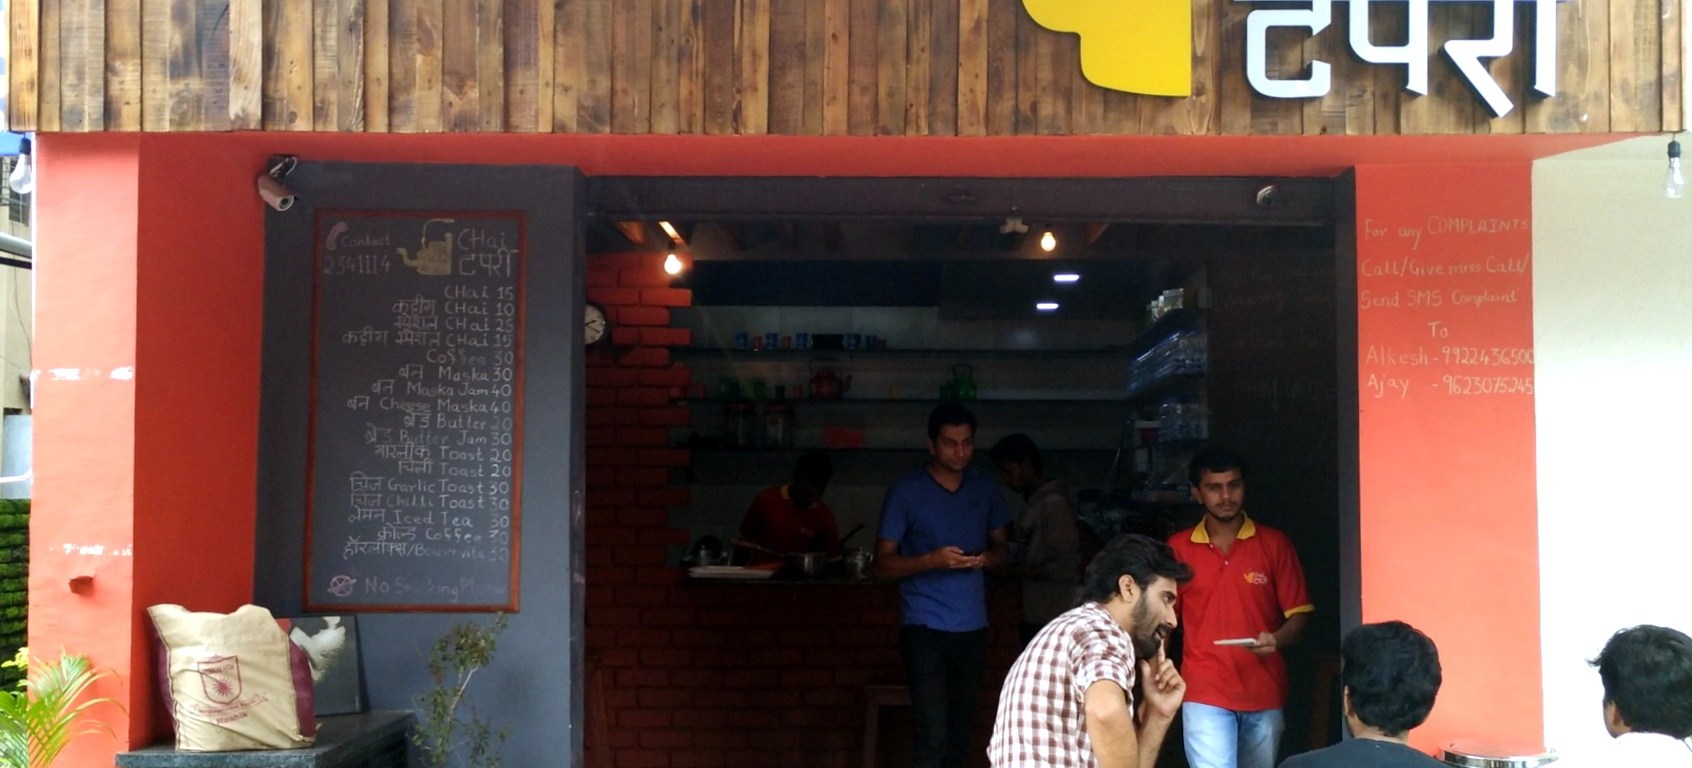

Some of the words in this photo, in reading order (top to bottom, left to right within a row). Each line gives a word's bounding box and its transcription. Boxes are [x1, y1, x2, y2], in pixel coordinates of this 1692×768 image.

[340, 234, 392, 248] Contact
[1364, 218, 1388, 240] For
[1398, 226, 1422, 250] any
[1427, 215, 1530, 235] COMPLAINTS
[324, 254, 391, 275] 2341114
[497, 286, 514, 301] 15
[1360, 290, 1400, 310] Send
[1407, 289, 1443, 307] SMS
[495, 302, 515, 317] 10
[494, 318, 514, 334] 25
[1428, 320, 1449, 338] To
[493, 334, 512, 348] 15
[494, 351, 514, 366] 30
[1364, 344, 1428, 366] Alkesh
[438, 366, 489, 382] Maska
[493, 367, 513, 382] 30
[406, 382, 454, 396] Maska
[458, 382, 488, 396] Jam
[491, 384, 512, 397] 40
[1367, 372, 1410, 400] Ajay
[379, 397, 431, 412] Cheese
[437, 398, 489, 414] Maska
[490, 400, 511, 414] 40
[437, 413, 486, 429] Butter
[400, 429, 449, 445] Butter
[457, 430, 487, 445] Jam
[491, 432, 512, 446] 30
[439, 446, 484, 461] Toast
[490, 448, 512, 463] 20
[439, 462, 484, 477] Toast
[490, 464, 512, 478] 20
[387, 478, 436, 493] Garlic
[437, 478, 484, 494] Toast
[489, 481, 510, 495] 30
[386, 495, 435, 509] Chilli
[439, 494, 485, 509] Toast
[489, 497, 510, 511] 30
[393, 509, 434, 525] Iced
[440, 511, 474, 528] Tea
[489, 513, 510, 528] 30
[365, 576, 390, 594] No
